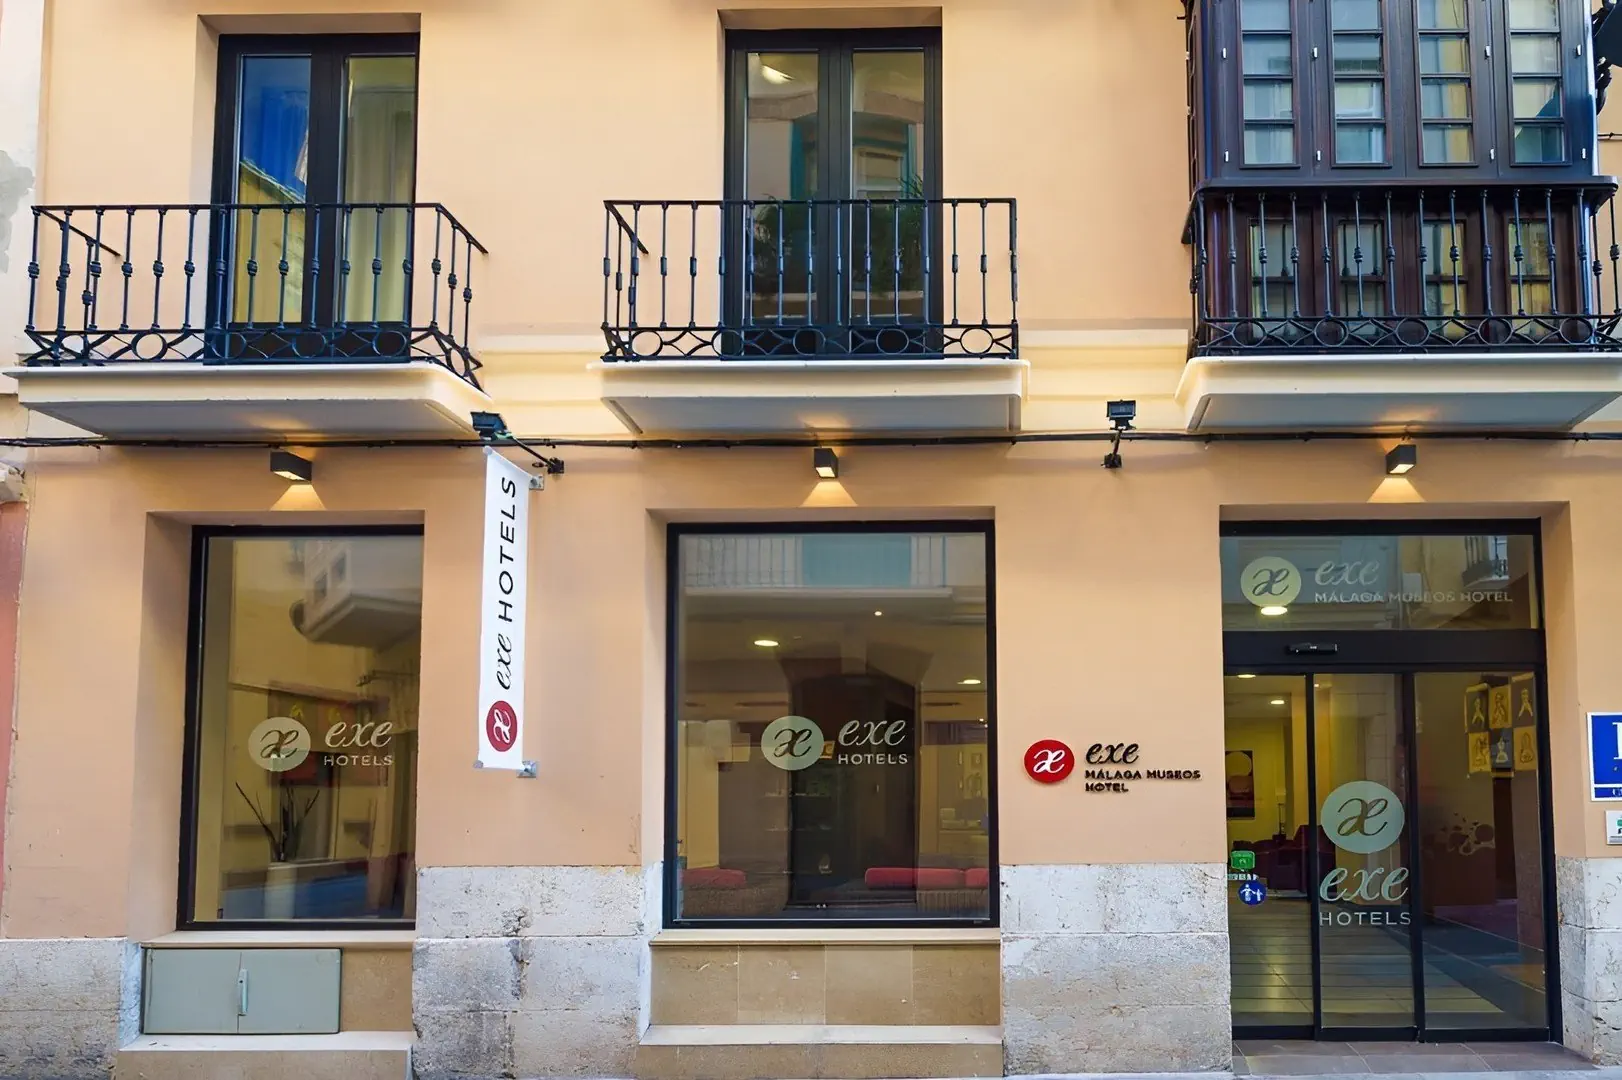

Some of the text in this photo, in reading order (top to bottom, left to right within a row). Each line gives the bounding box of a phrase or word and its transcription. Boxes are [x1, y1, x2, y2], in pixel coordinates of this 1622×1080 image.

[1314, 560, 1381, 586] exe
[496, 476, 516, 690] exe HOTELS
[1460, 590, 1513, 602] HOTEL
[325, 721, 393, 748] exe
[838, 719, 906, 747] exe
[323, 755, 393, 766] HOTELS
[838, 753, 909, 765] HOTELS
[1085, 742, 1140, 765] exe
[1085, 768, 1201, 780] MÁLAGA MUSEOS
[1085, 782, 1129, 793] HOTEL
[1319, 867, 1409, 902] exe
[1319, 911, 1412, 926] HOTELS
